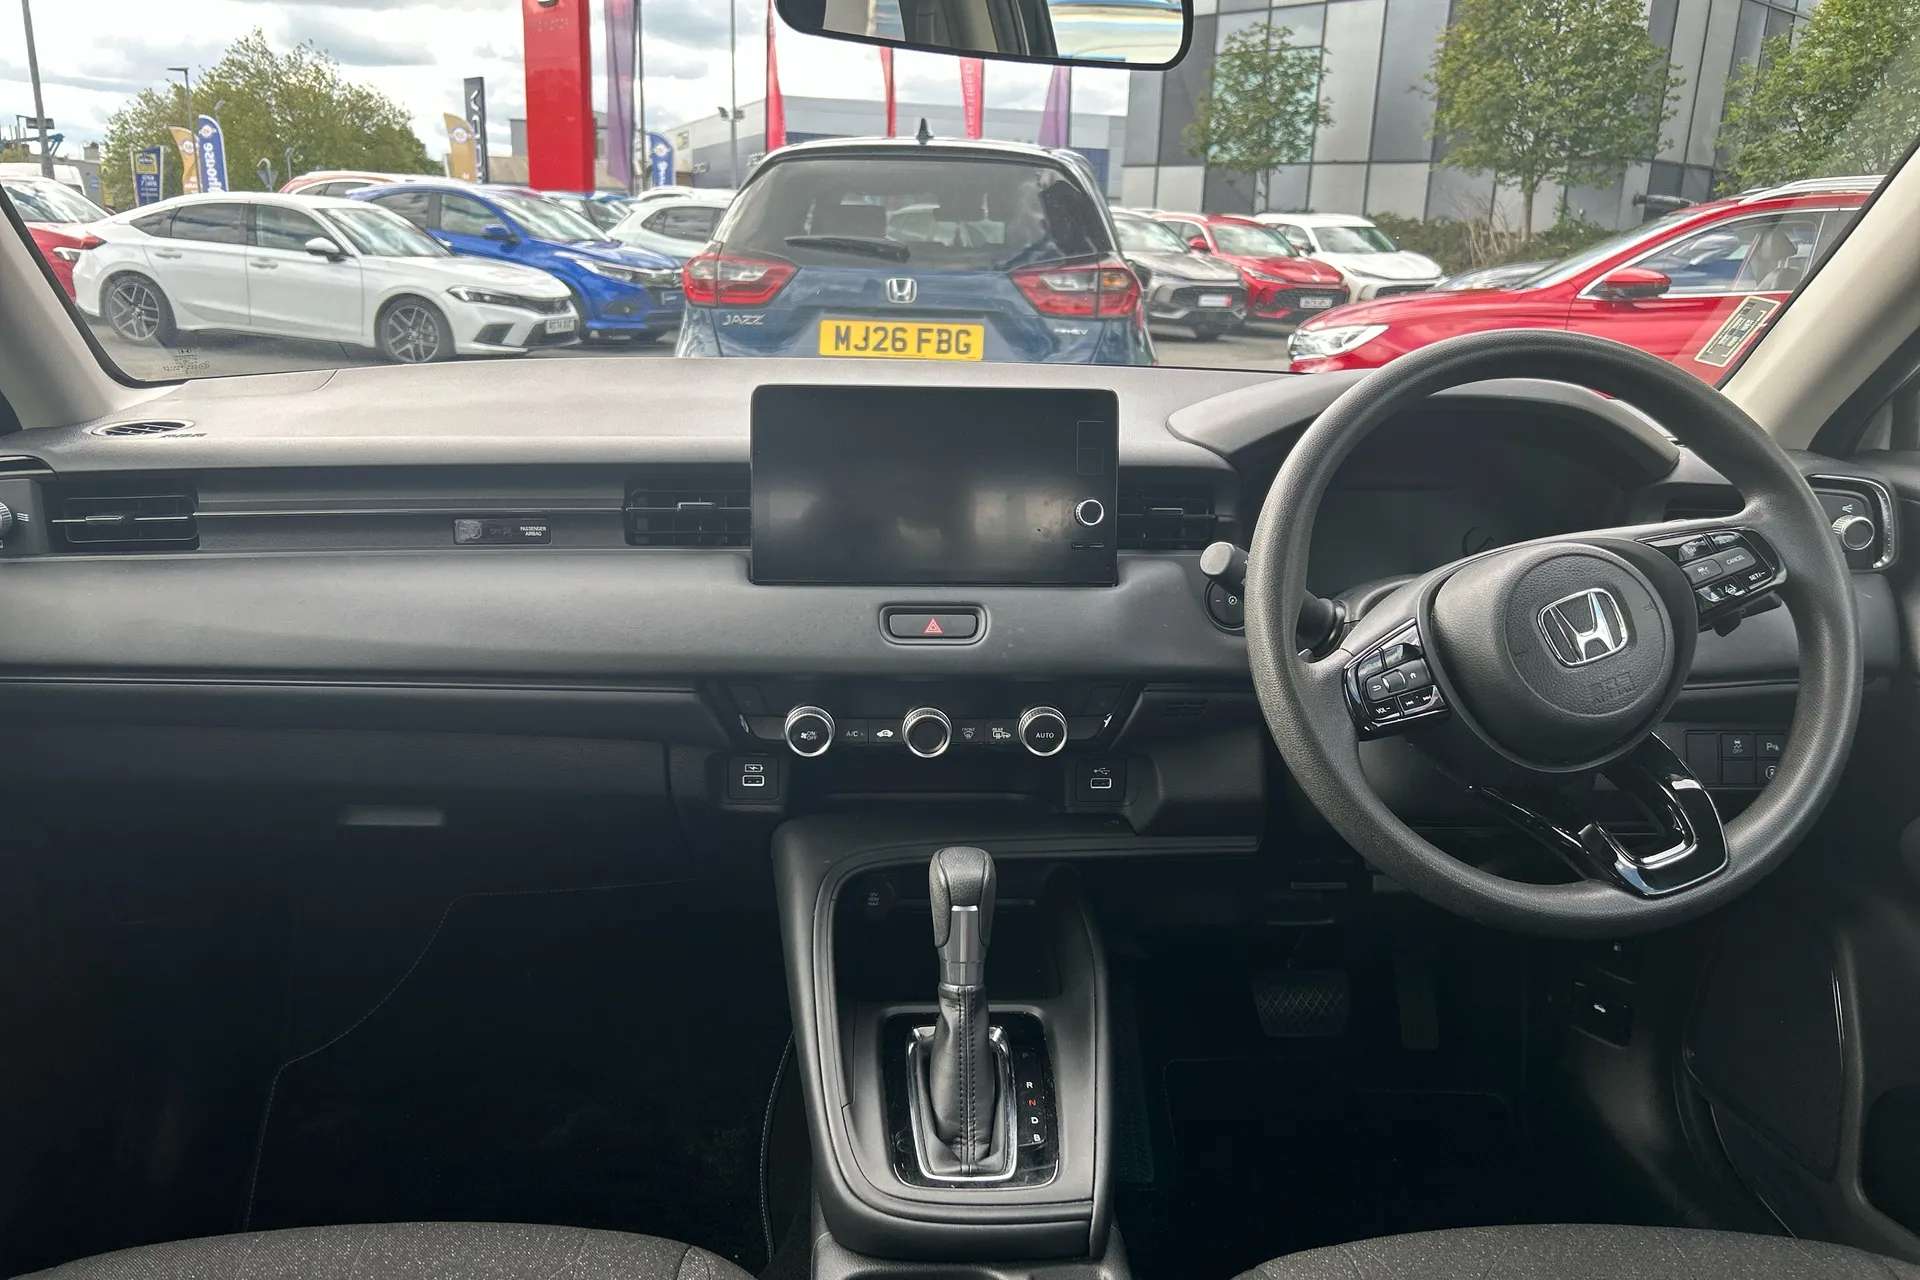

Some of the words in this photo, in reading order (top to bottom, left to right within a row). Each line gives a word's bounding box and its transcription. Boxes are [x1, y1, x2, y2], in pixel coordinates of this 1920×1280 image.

[722, 314, 765, 326] JAZZ
[834, 325, 908, 352] MJ26
[916, 328, 973, 355] FBG
[1035, 732, 1055, 740] AUTO
[1033, 1133, 1041, 1142] B
